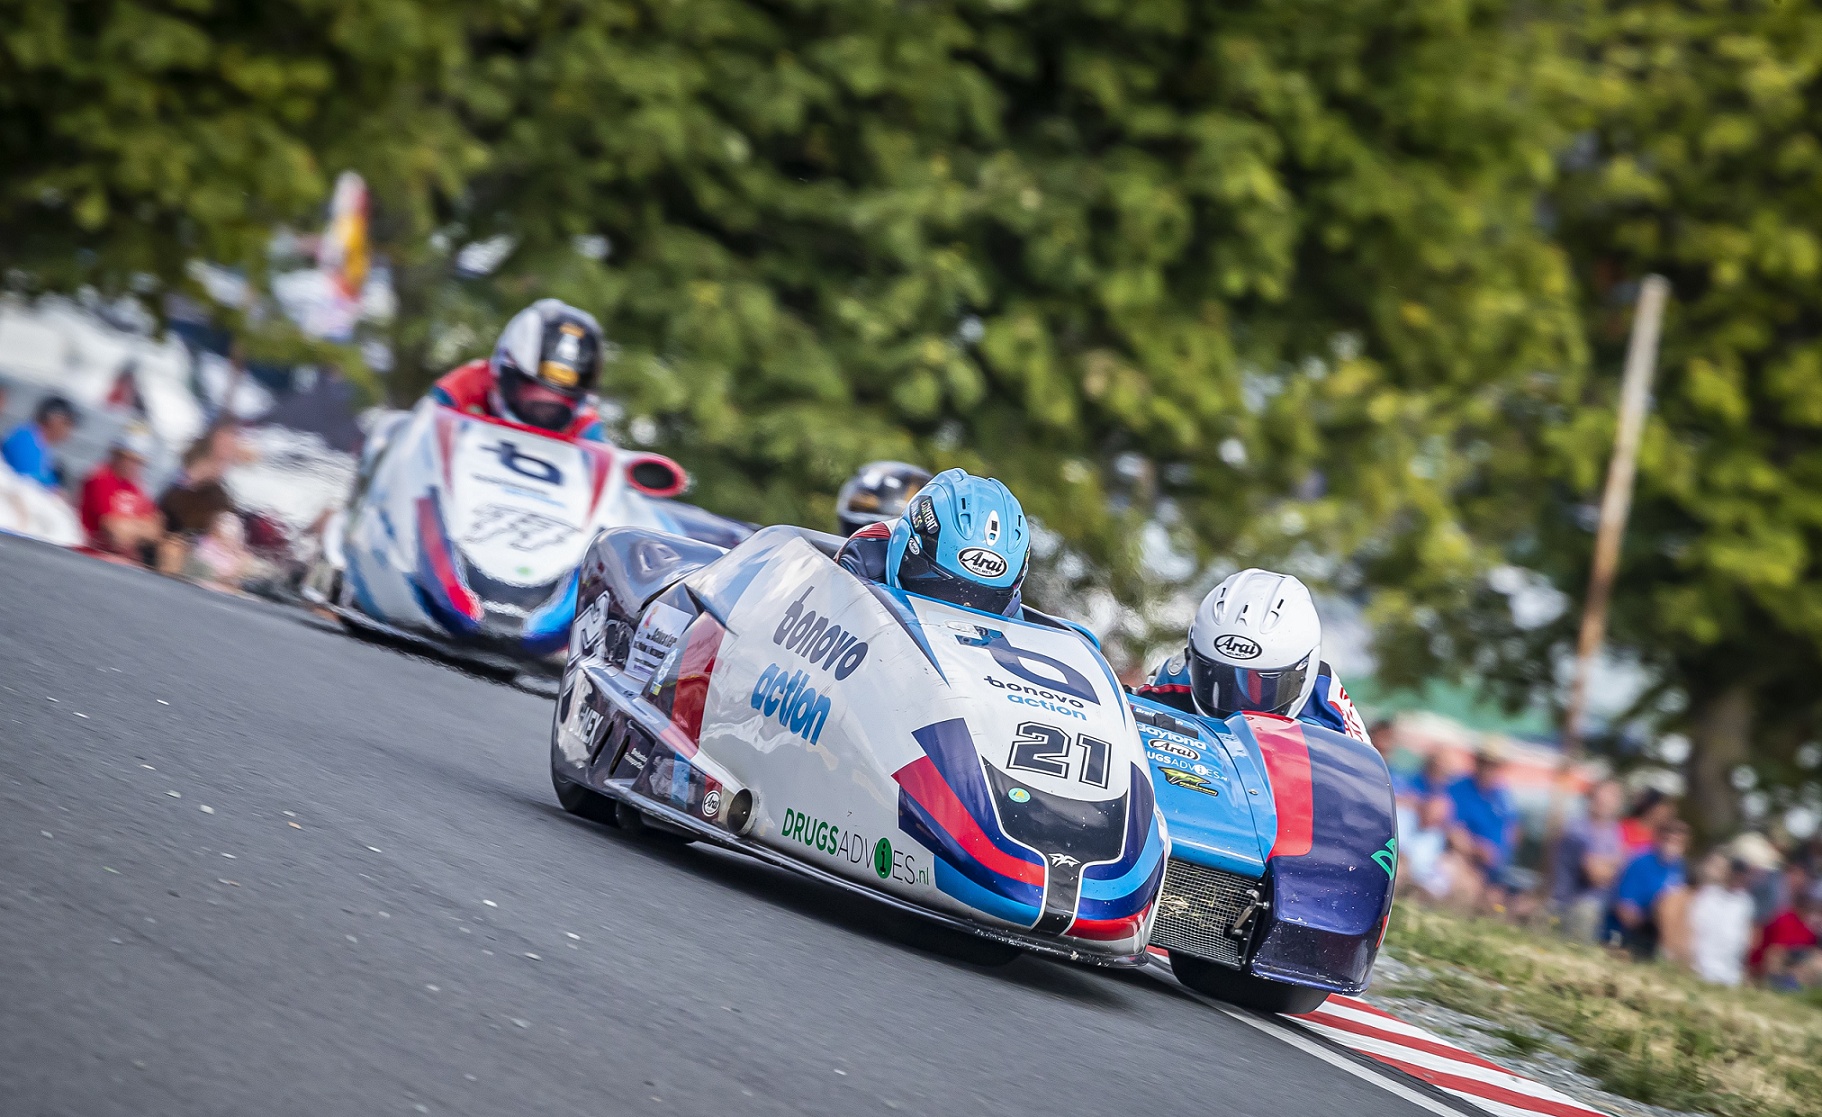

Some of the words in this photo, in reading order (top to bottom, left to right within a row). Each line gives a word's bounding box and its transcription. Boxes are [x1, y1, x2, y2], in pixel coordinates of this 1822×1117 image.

[961, 551, 1003, 573] Arai
[773, 586, 868, 681] bonovo
[1216, 636, 1257, 655] Arai
[751, 663, 832, 746] action
[983, 675, 1085, 709] bonovo
[1007, 694, 1088, 721] action
[1006, 720, 1112, 789] 21
[1153, 742, 1193, 758] Arai
